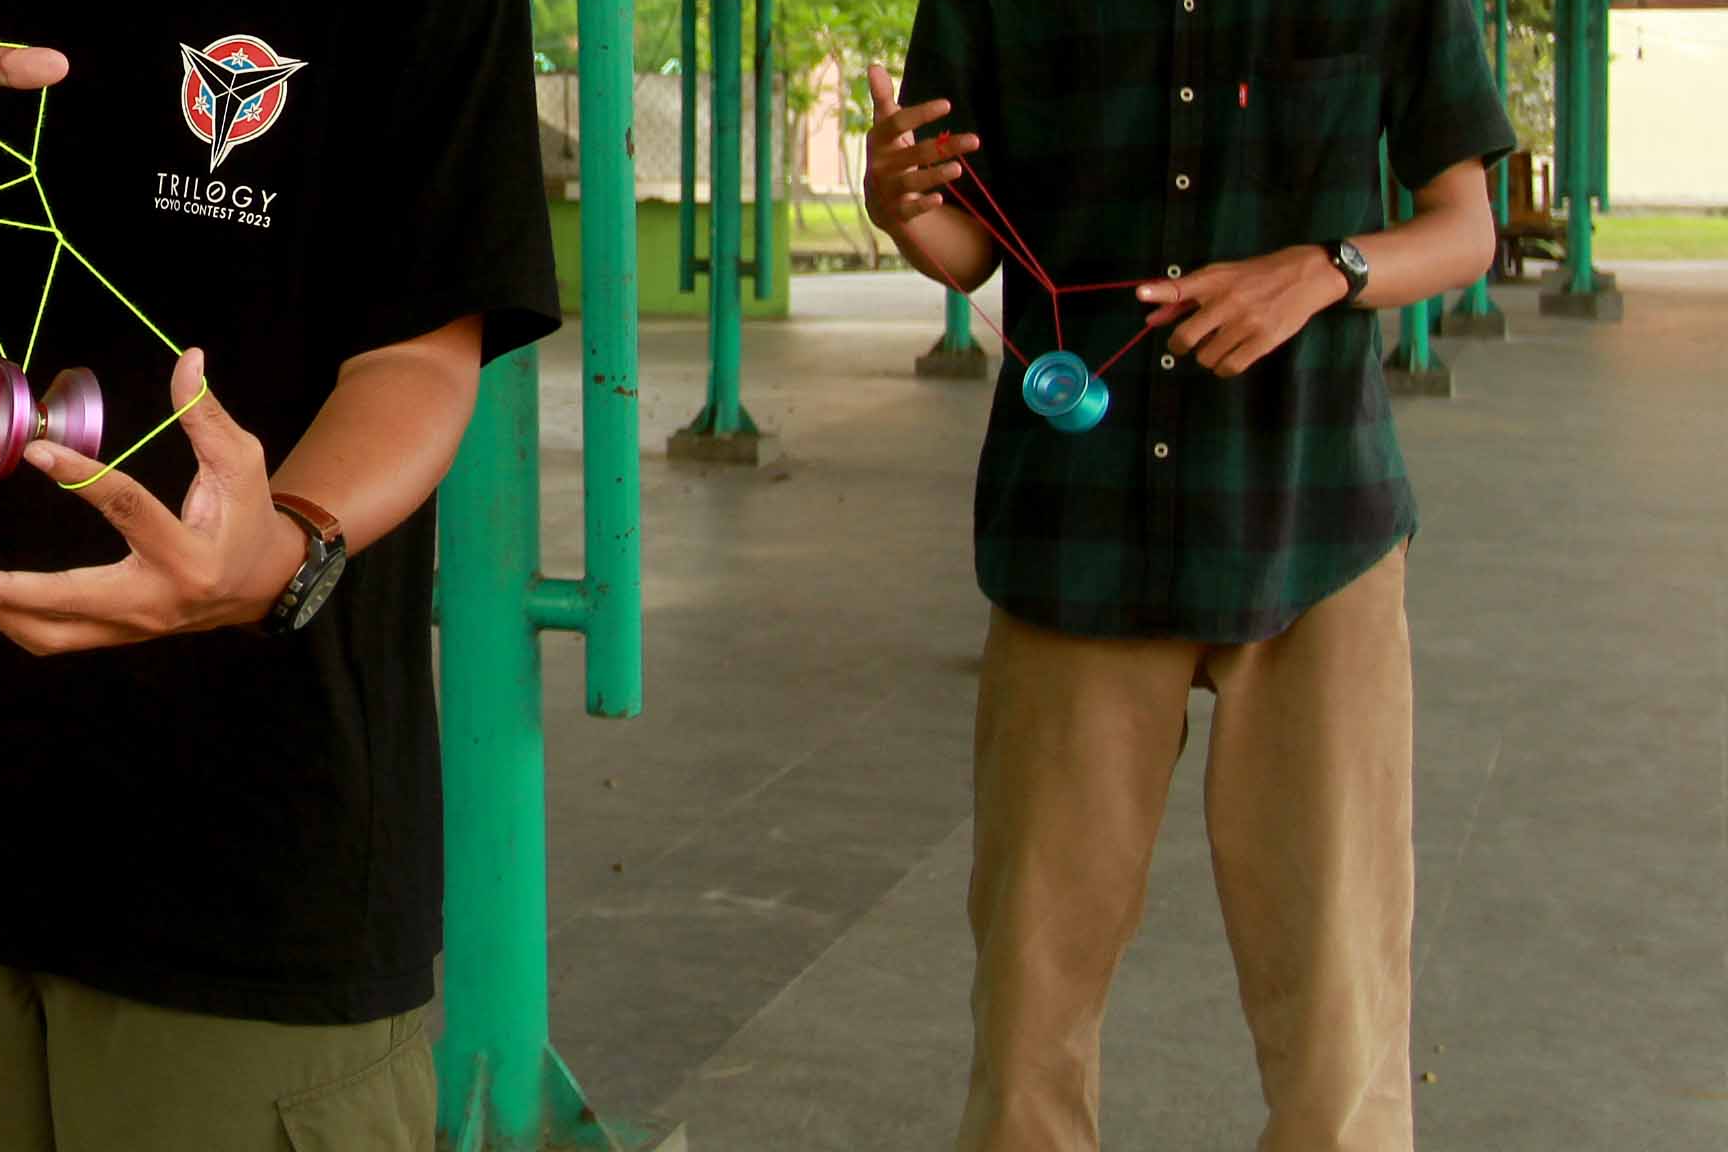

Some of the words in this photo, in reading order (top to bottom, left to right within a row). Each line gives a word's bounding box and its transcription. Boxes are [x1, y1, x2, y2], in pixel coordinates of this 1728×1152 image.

[154, 196, 181, 212] YOYO
[183, 201, 235, 221] CONTEST
[237, 211, 271, 228] 2023
